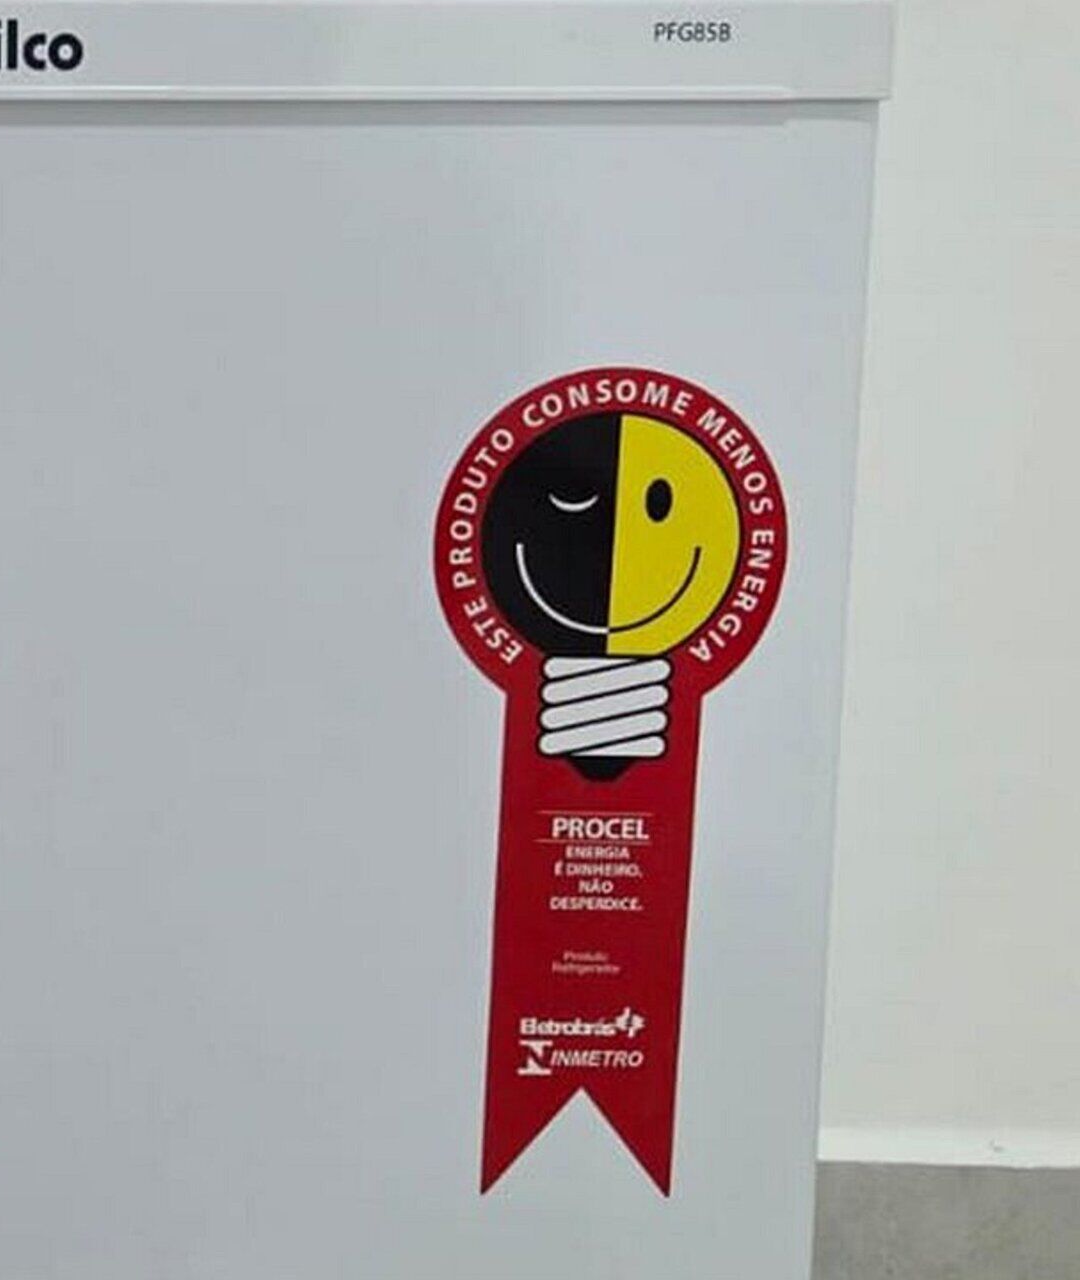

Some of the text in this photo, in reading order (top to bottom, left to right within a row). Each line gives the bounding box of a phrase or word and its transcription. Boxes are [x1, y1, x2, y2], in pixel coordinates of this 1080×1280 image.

[449, 378, 775, 665] ESTE PRODUTO CONSOME MENOS ENERGIA
[551, 817, 650, 839] PROCEL
[565, 845, 631, 860] ENERGIA
[578, 878, 615, 894] NÃO
[549, 1050, 644, 1069] INMETRO
